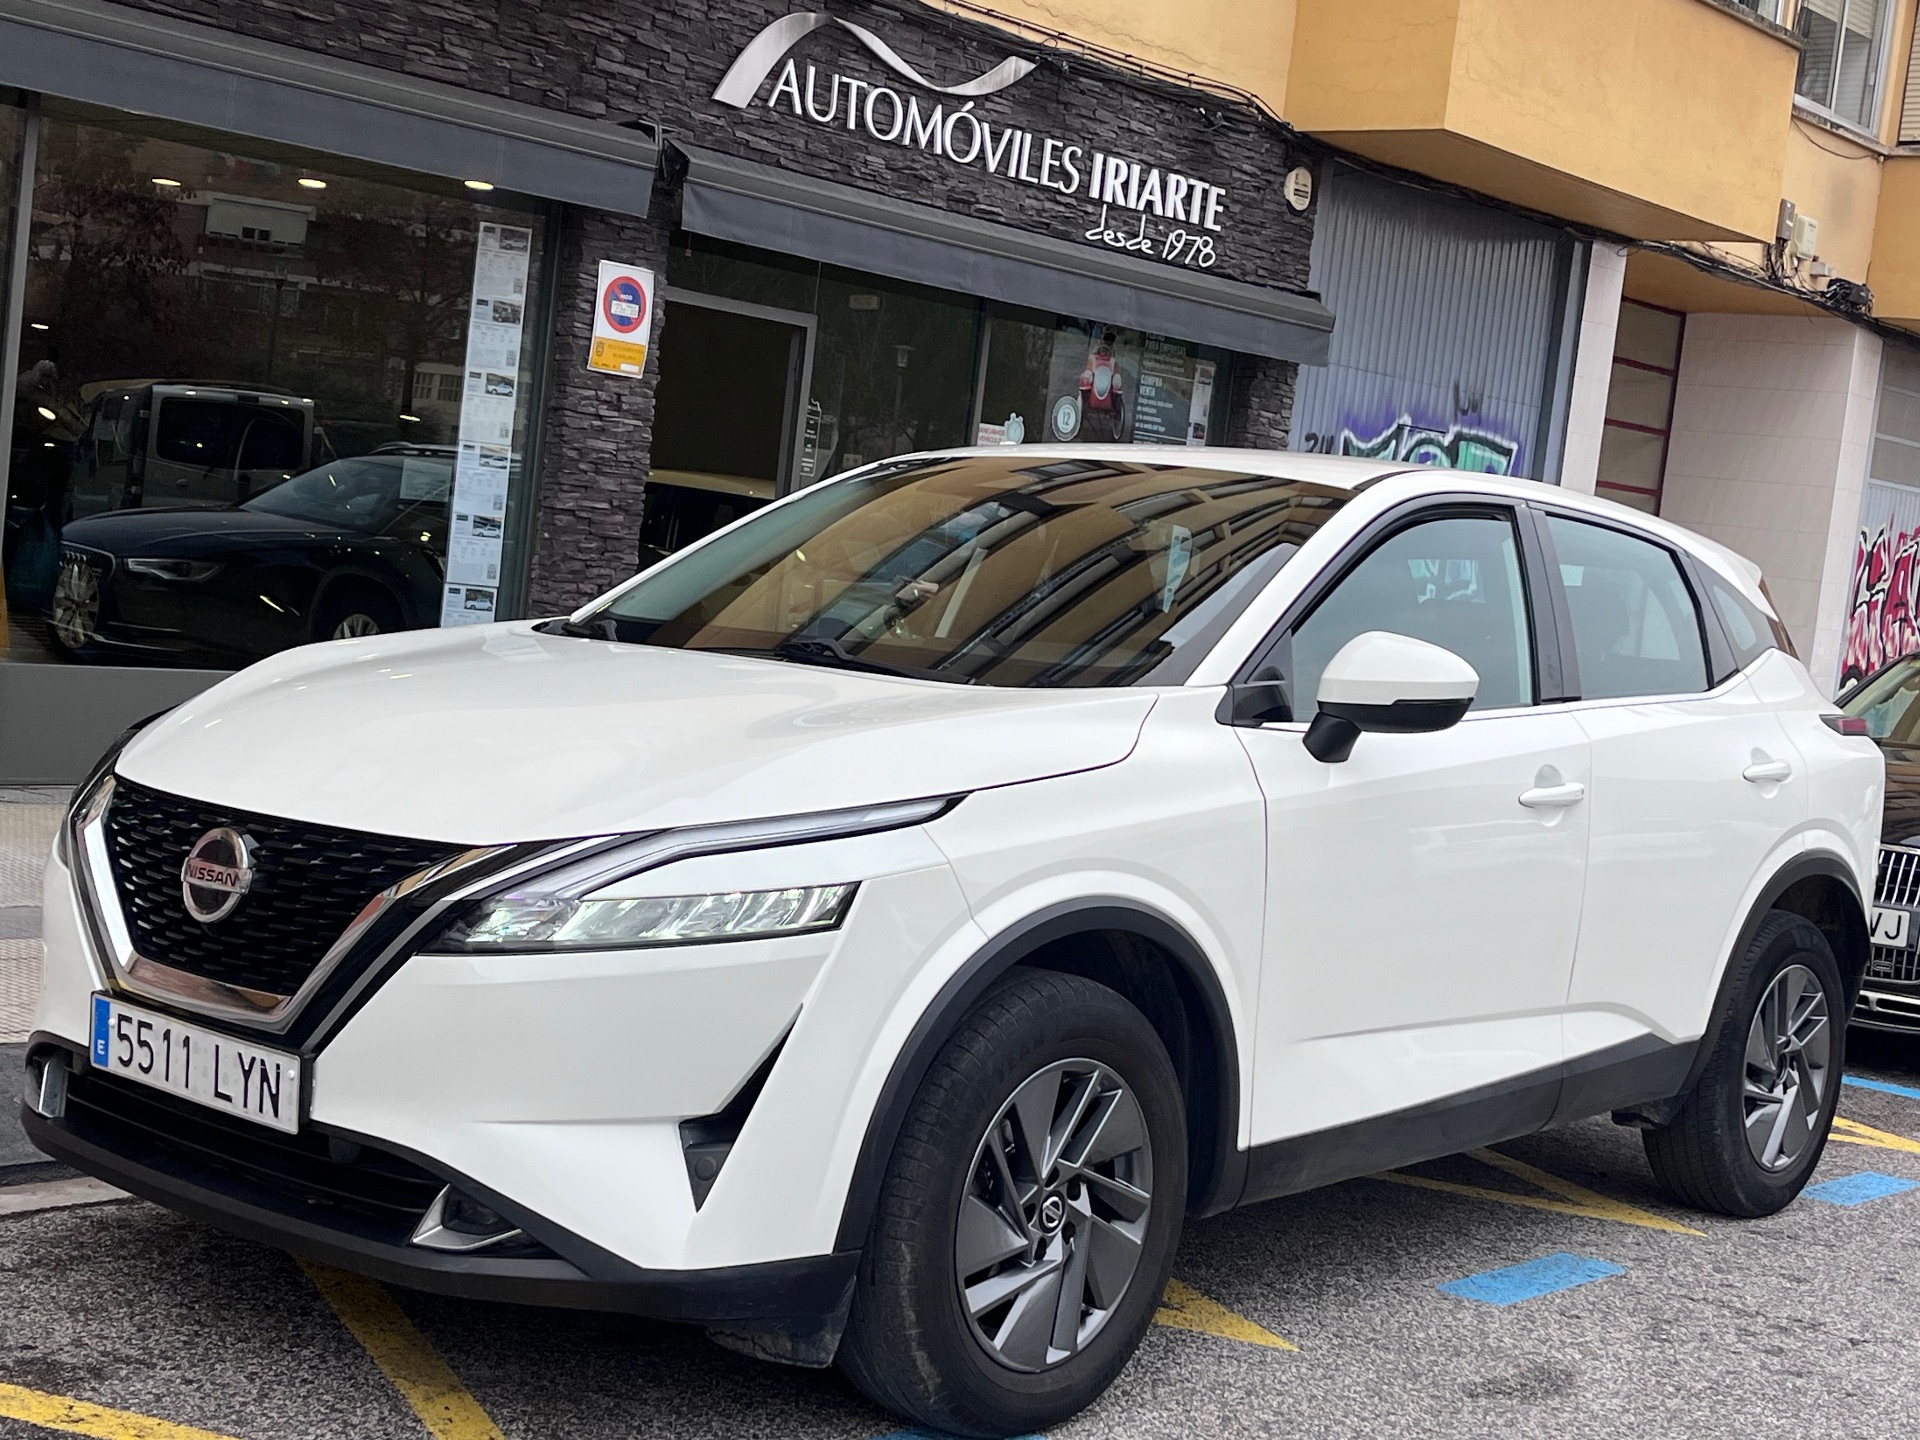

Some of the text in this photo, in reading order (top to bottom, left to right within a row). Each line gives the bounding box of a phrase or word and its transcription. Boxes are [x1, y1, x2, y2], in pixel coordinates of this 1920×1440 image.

[767, 58, 1226, 232] AUTOMÓVILES IRIARTE
[1085, 203, 1216, 268] desde 1978
[1139, 385, 1156, 397] VENTA
[1140, 374, 1163, 388] COMPRA
[1062, 411, 1071, 426] 12
[187, 863, 239, 887] NISSAN
[97, 1013, 281, 1119] E 5511 LYN
